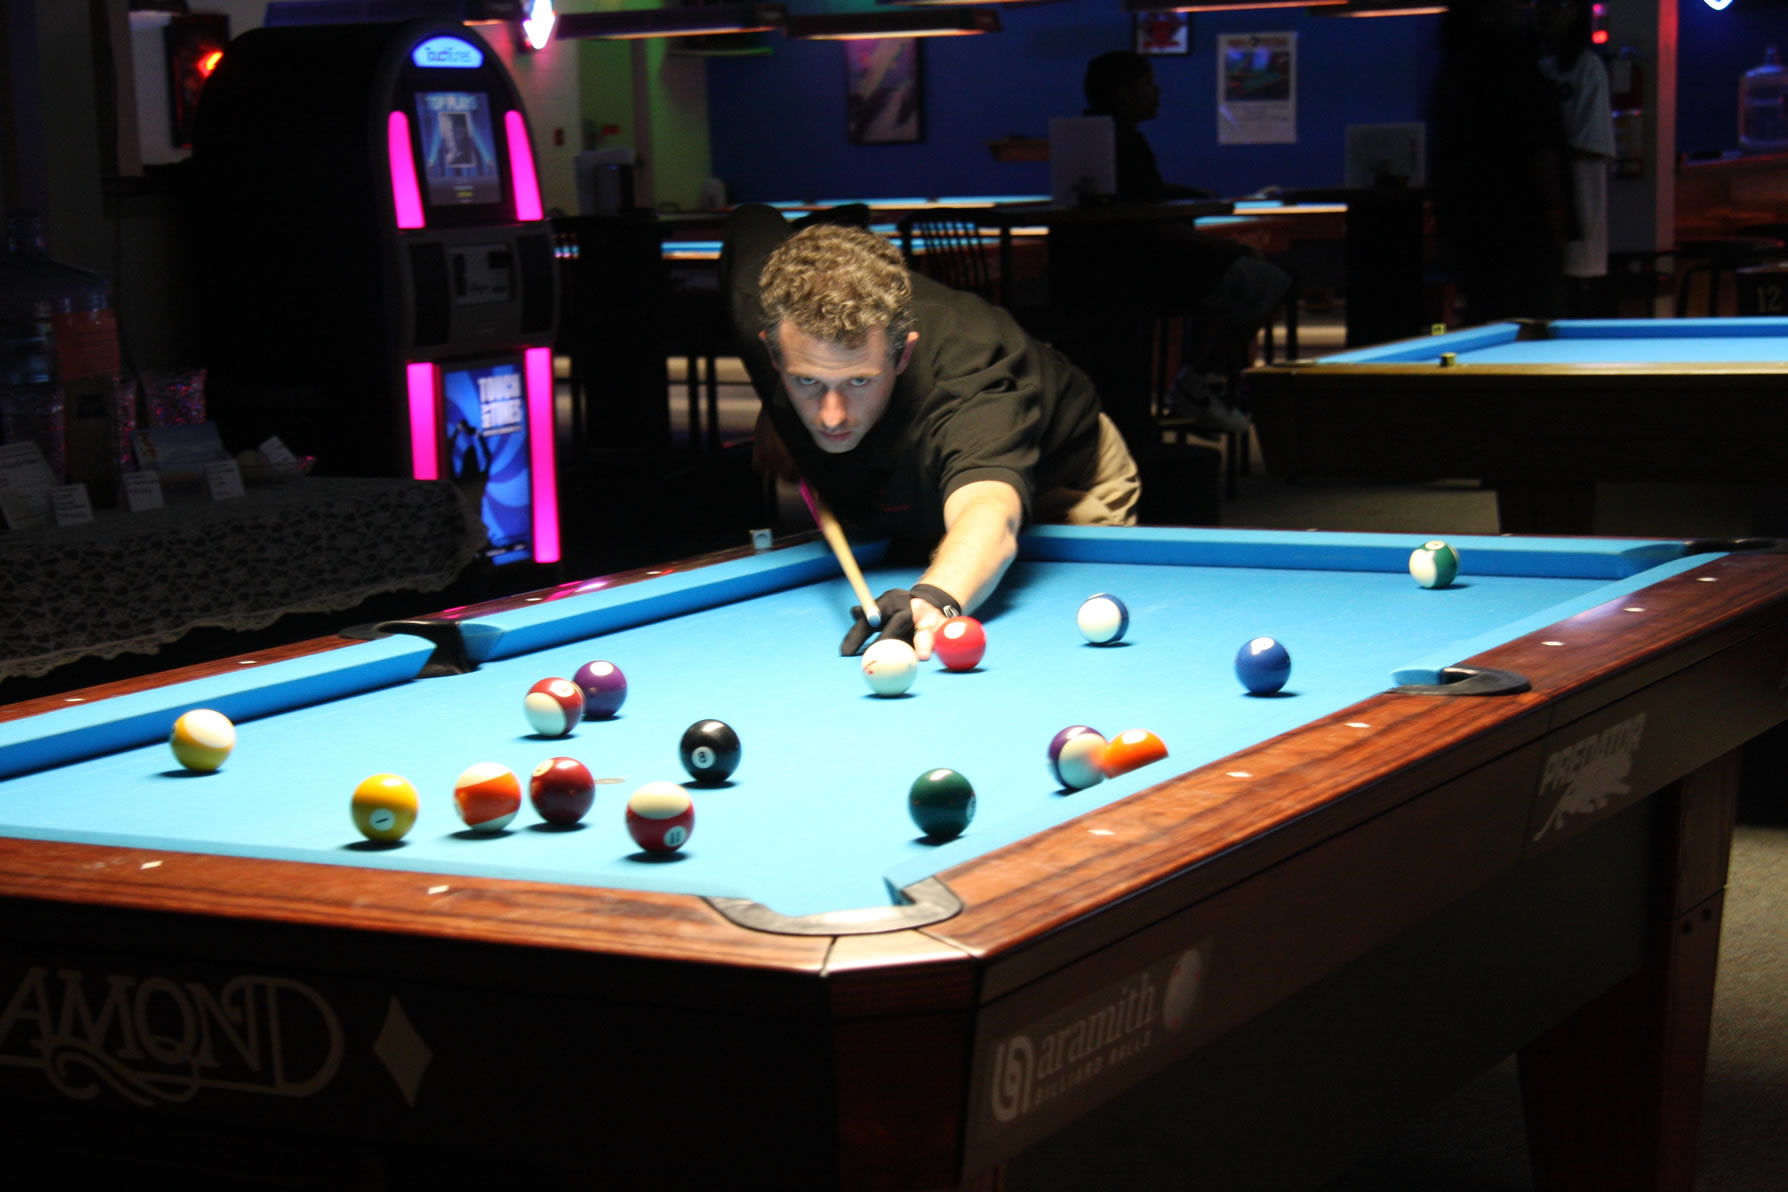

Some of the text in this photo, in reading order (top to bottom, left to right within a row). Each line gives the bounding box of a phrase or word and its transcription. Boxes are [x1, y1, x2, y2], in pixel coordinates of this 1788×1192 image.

[1756, 285, 1784, 313] 12
[698, 751, 707, 764] 8
[670, 831, 681, 845] 11
[0, 967, 345, 1106] AMOND
[1036, 972, 1156, 1079] aramith
